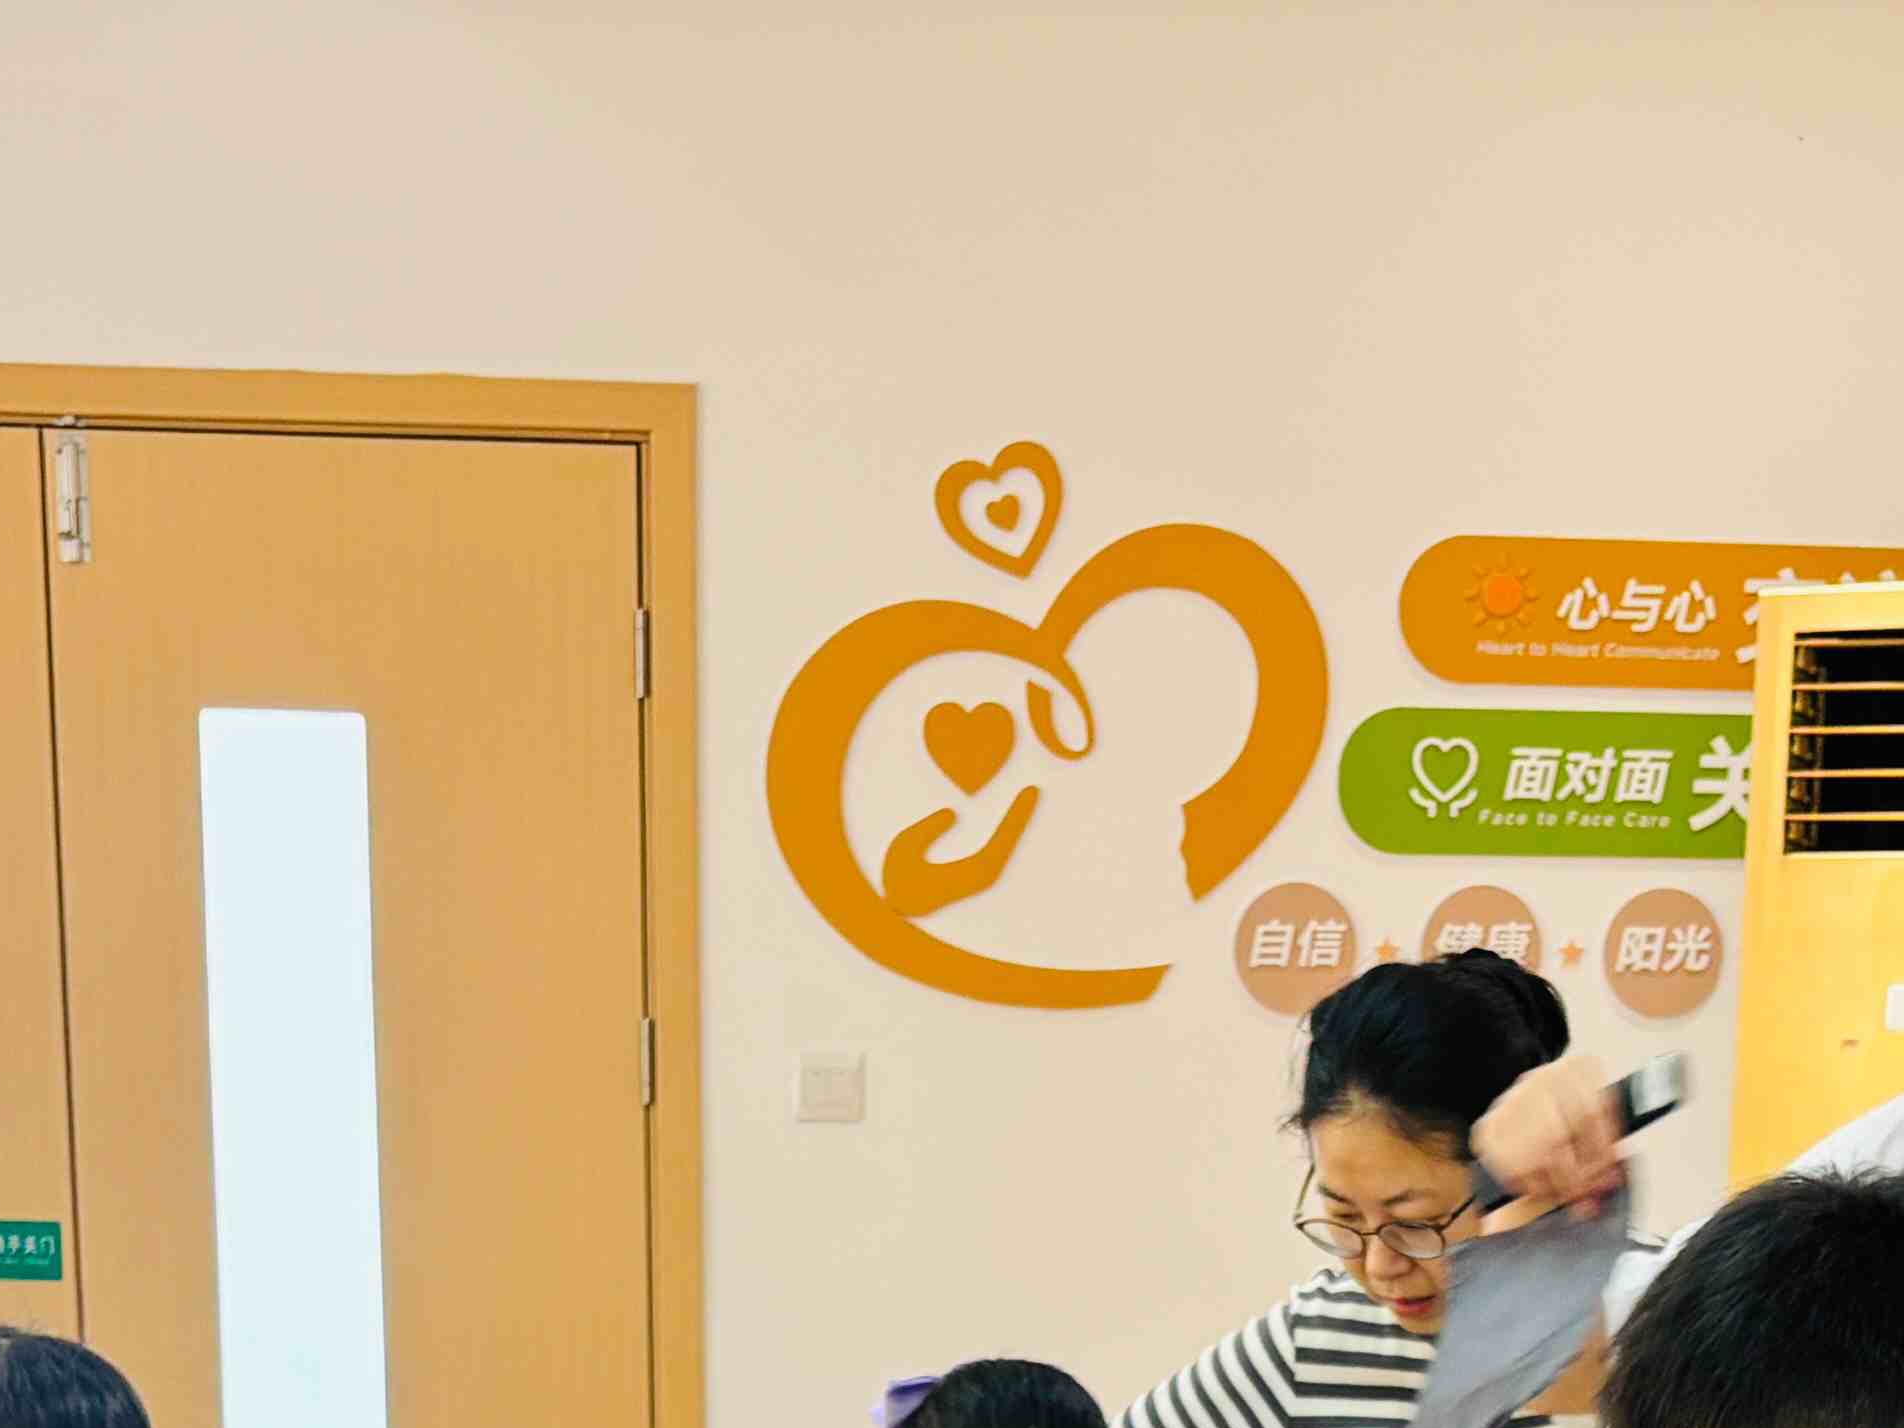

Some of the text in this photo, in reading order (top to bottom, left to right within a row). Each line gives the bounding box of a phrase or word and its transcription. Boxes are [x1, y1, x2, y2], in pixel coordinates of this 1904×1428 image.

[1557, 577, 1717, 634] 心与心
[1476, 640, 1721, 661] Heart to Heart Communicate
[1503, 746, 1674, 804] 面对面
[1478, 809, 1671, 828] Face to Face Care
[1249, 920, 1347, 968] 自信
[1615, 924, 1713, 972] 阳光
